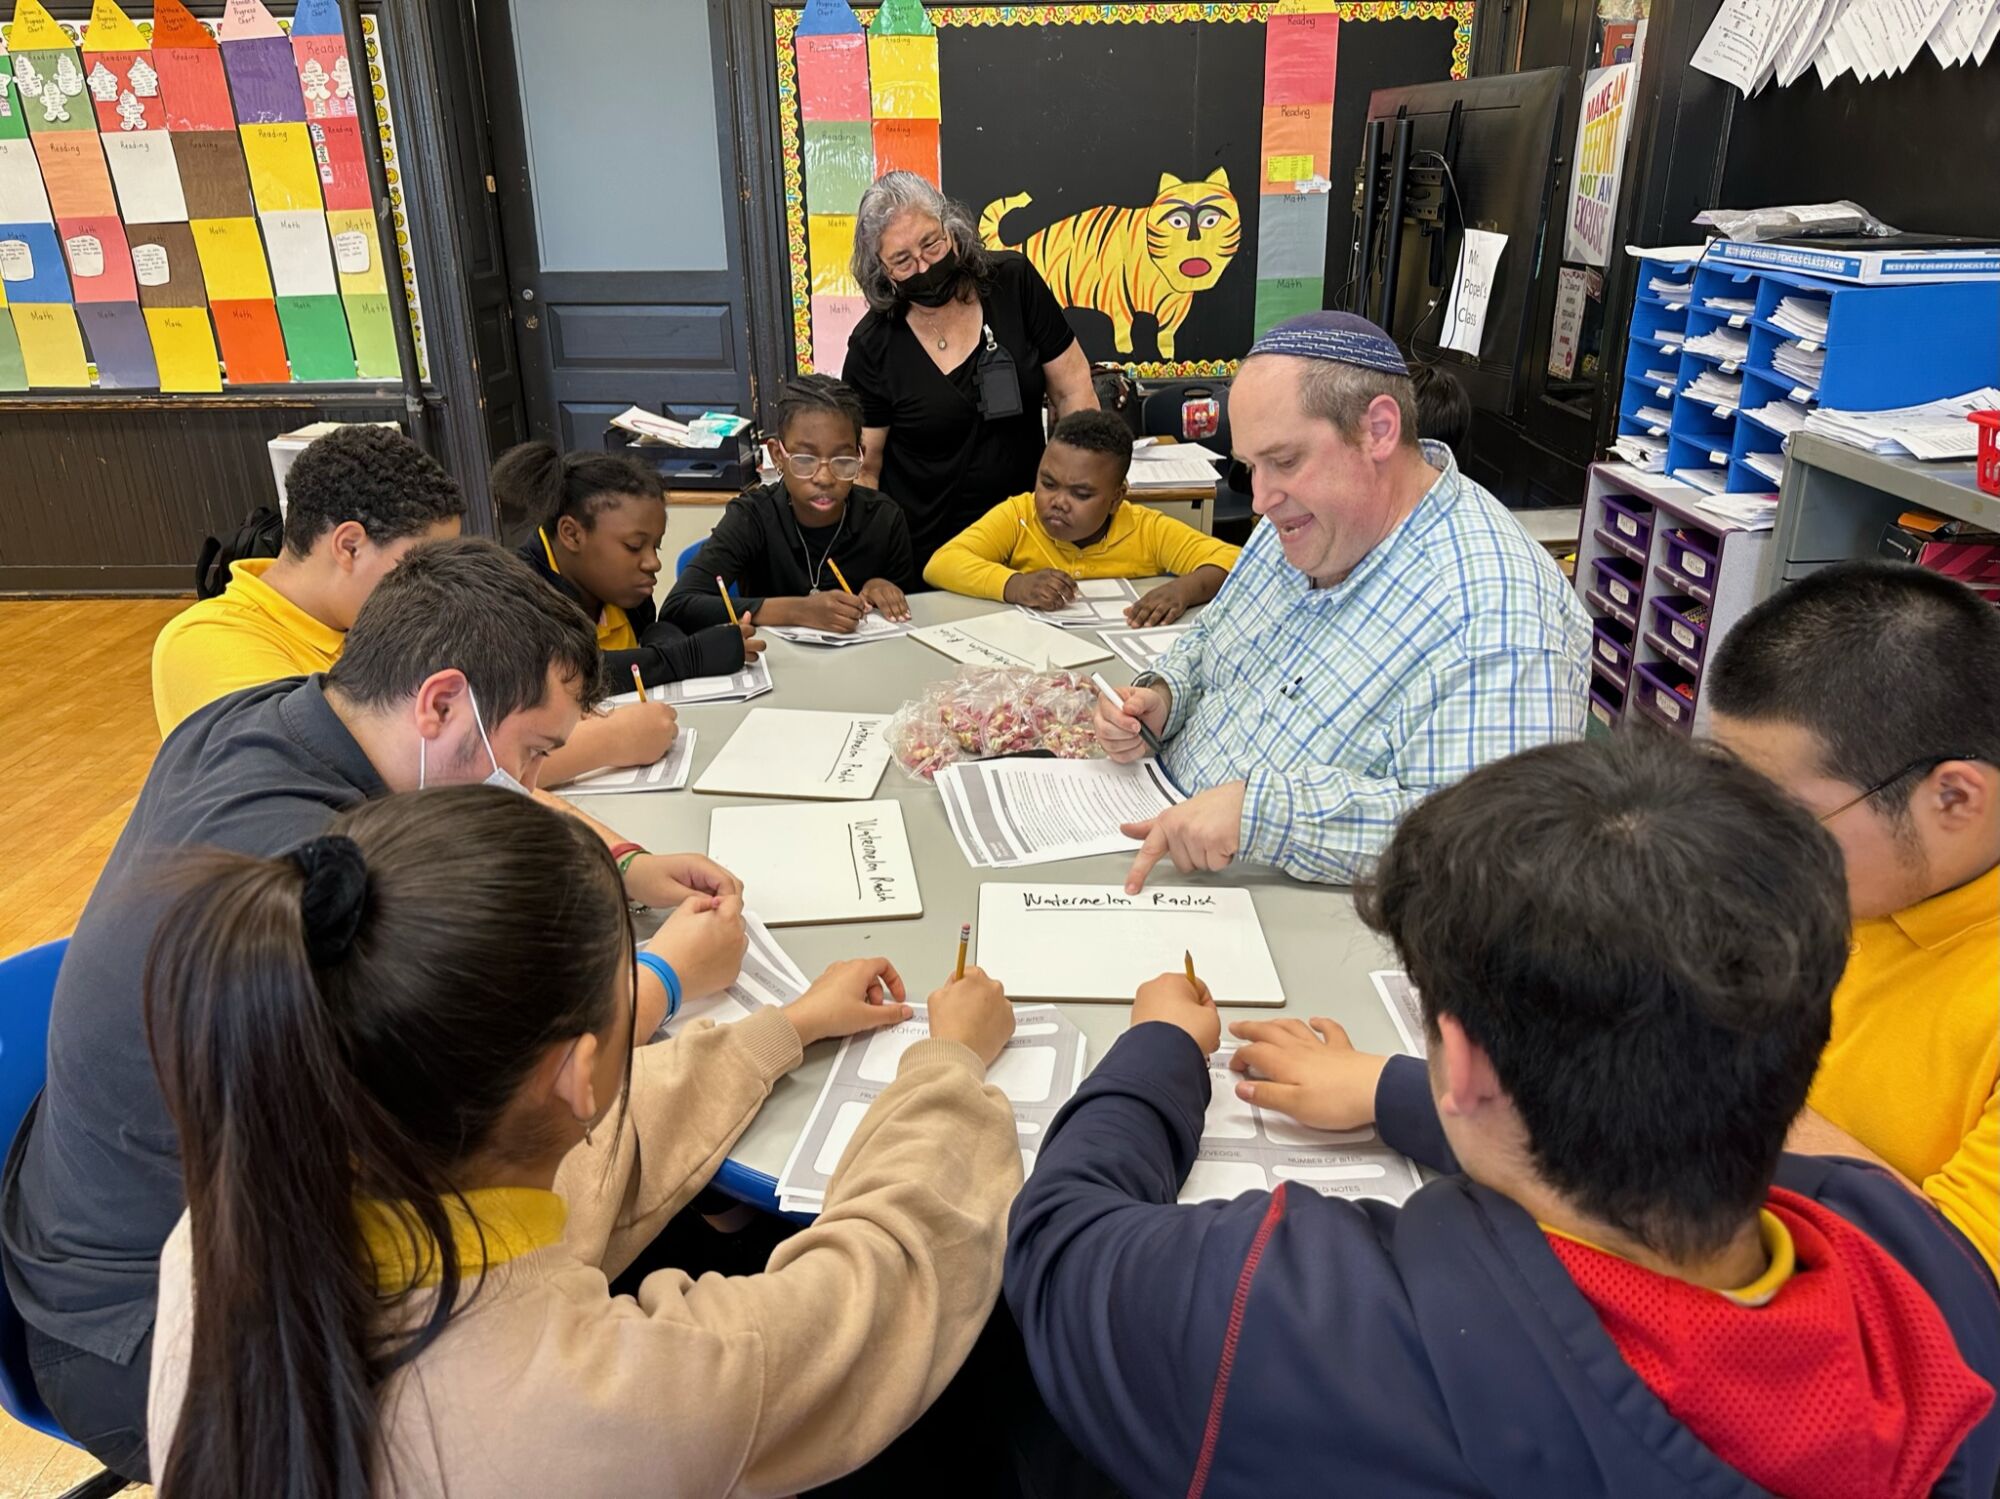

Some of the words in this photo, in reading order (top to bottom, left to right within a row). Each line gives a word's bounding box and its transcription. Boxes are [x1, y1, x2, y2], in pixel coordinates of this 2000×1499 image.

[1287, 16, 1316, 29] Reading
[1585, 81, 1613, 126] MAKE
[1611, 67, 1629, 108] AN
[1281, 105, 1311, 118] Reading
[258, 128, 288, 142] Reading
[822, 132, 856, 145] Reading
[1580, 105, 1623, 174] EFFORT
[50, 143, 81, 156] Reading
[120, 141, 149, 151] Reading
[1578, 174, 1599, 199] NOT
[1597, 176, 1614, 204] AN
[1283, 193, 1307, 204] Math
[281, 221, 300, 230] Math
[828, 219, 847, 228] Math
[1574, 194, 1609, 257] EXCUSE
[209, 226, 227, 235] Math
[1468, 249, 1480, 266] Mr.
[1777, 251, 1802, 267] PENCILS
[1803, 255, 1825, 269] CLASS
[1825, 257, 1845, 273] PACK
[1277, 278, 1303, 289] Math
[232, 309, 253, 320] Math
[362, 303, 387, 314] Math
[829, 303, 851, 314] Math
[30, 311, 54, 321] Math
[1458, 307, 1477, 326] Class
[855, 818, 887, 873] Watermelon
[1023, 891, 1132, 907] Watermelon
[1152, 892, 1217, 907] Radish
[1288, 1155, 1323, 1165] NUMBER
[1325, 1155, 1336, 1163] OF
[1339, 1155, 1363, 1163] BITES
[1332, 1185, 1361, 1193] NOTES
